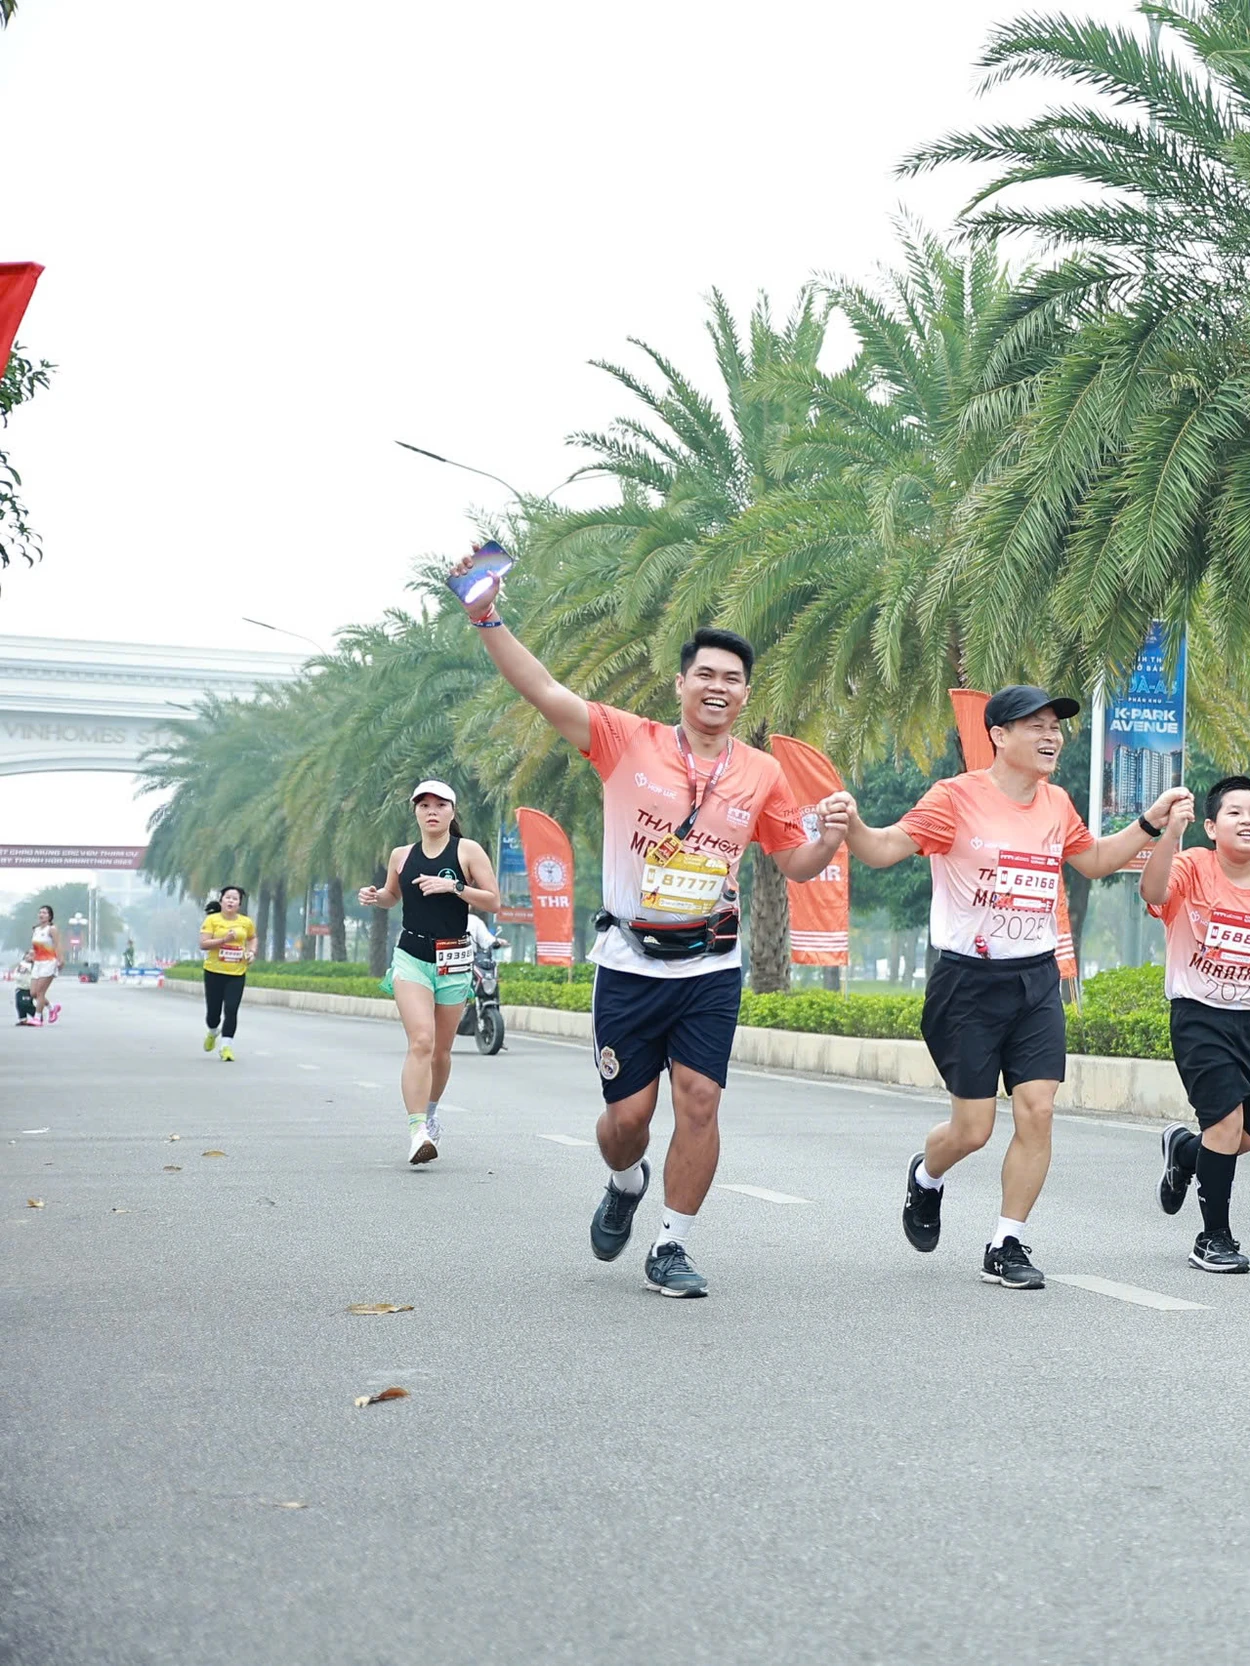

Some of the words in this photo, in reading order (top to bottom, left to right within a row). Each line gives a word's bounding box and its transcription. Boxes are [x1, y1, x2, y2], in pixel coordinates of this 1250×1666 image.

[1114, 707, 1176, 721] K-PARK
[4, 722, 127, 744] VINHOMES
[1110, 720, 1178, 734] AVENUE
[637, 808, 705, 844] THAH
[662, 874, 718, 891] 87777
[1014, 874, 1055, 890] 62168
[537, 895, 570, 908] THR
